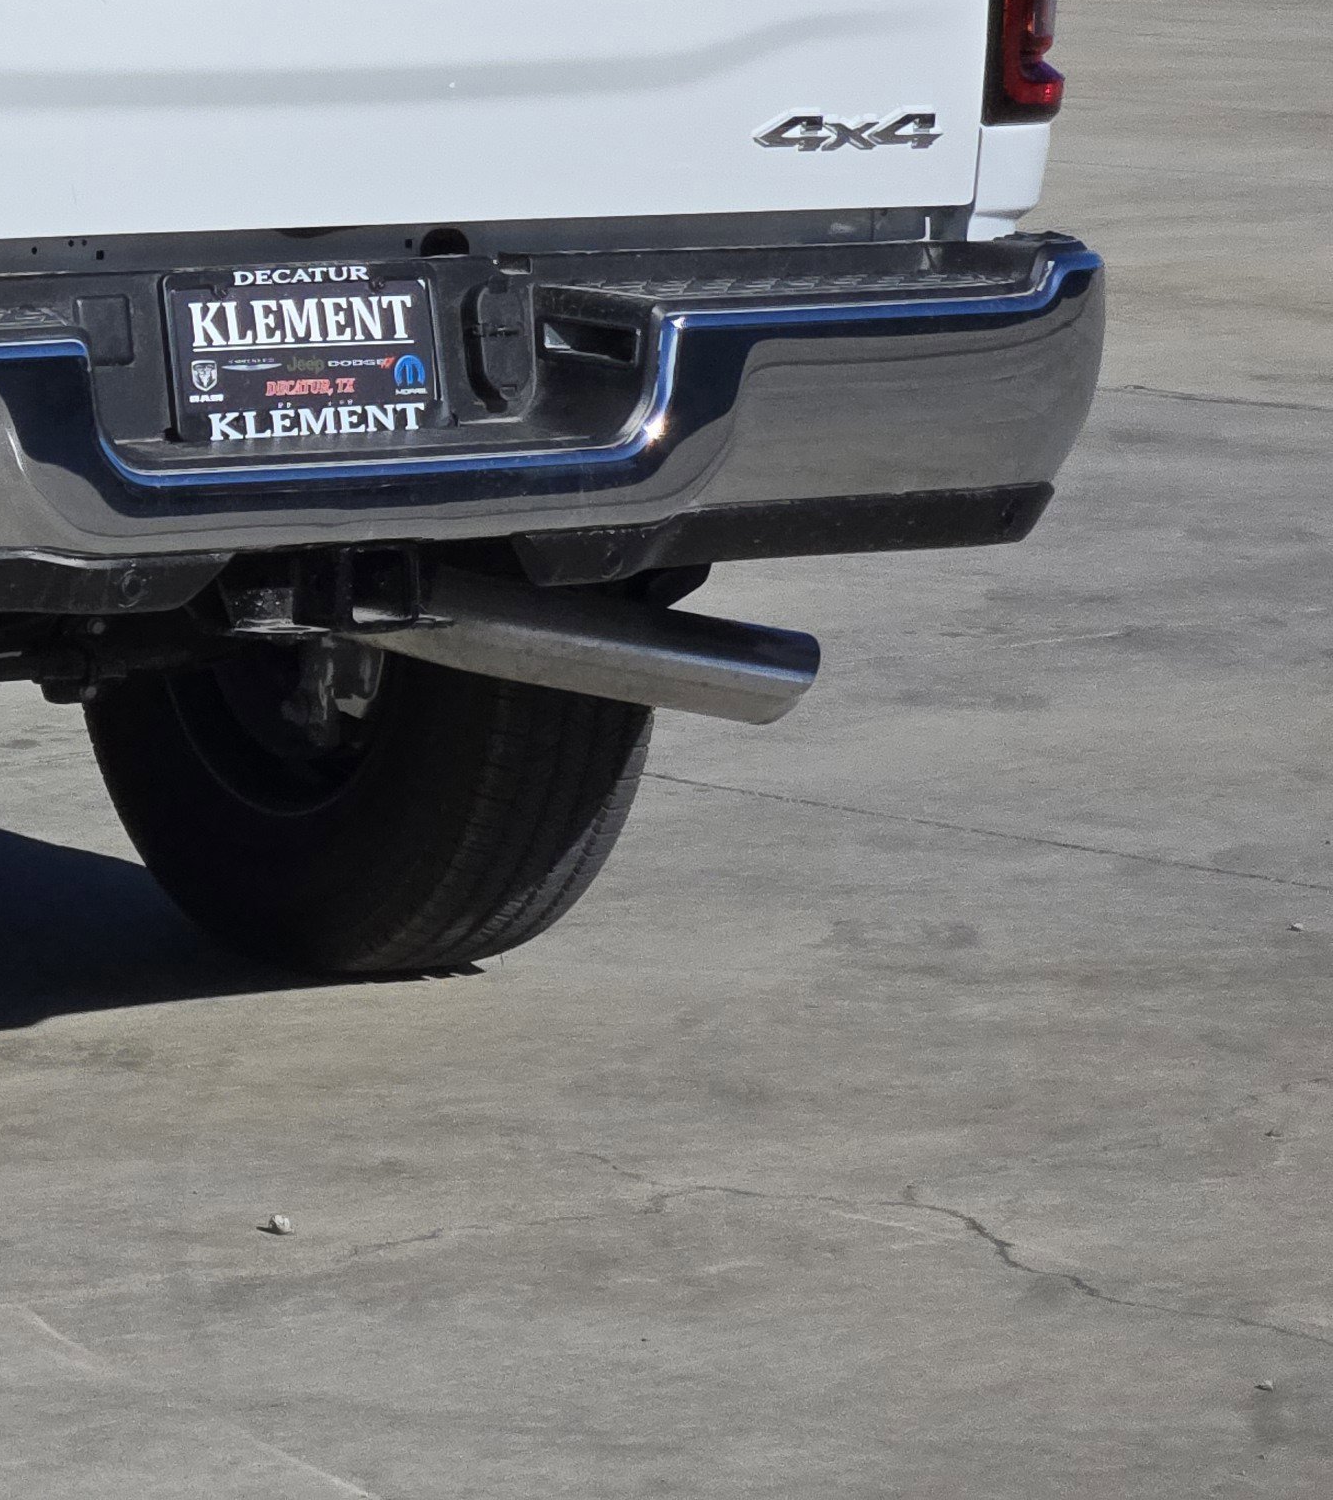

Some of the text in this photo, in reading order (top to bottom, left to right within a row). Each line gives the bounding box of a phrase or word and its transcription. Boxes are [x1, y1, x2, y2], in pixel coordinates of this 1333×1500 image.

[233, 266, 370, 286] DECATUR
[188, 295, 412, 347] KLEMENT
[287, 357, 325, 374] Jeep
[328, 359, 385, 367] DODGE
[265, 379, 333, 397] DECATUR,
[208, 403, 425, 442] KLEMENT
